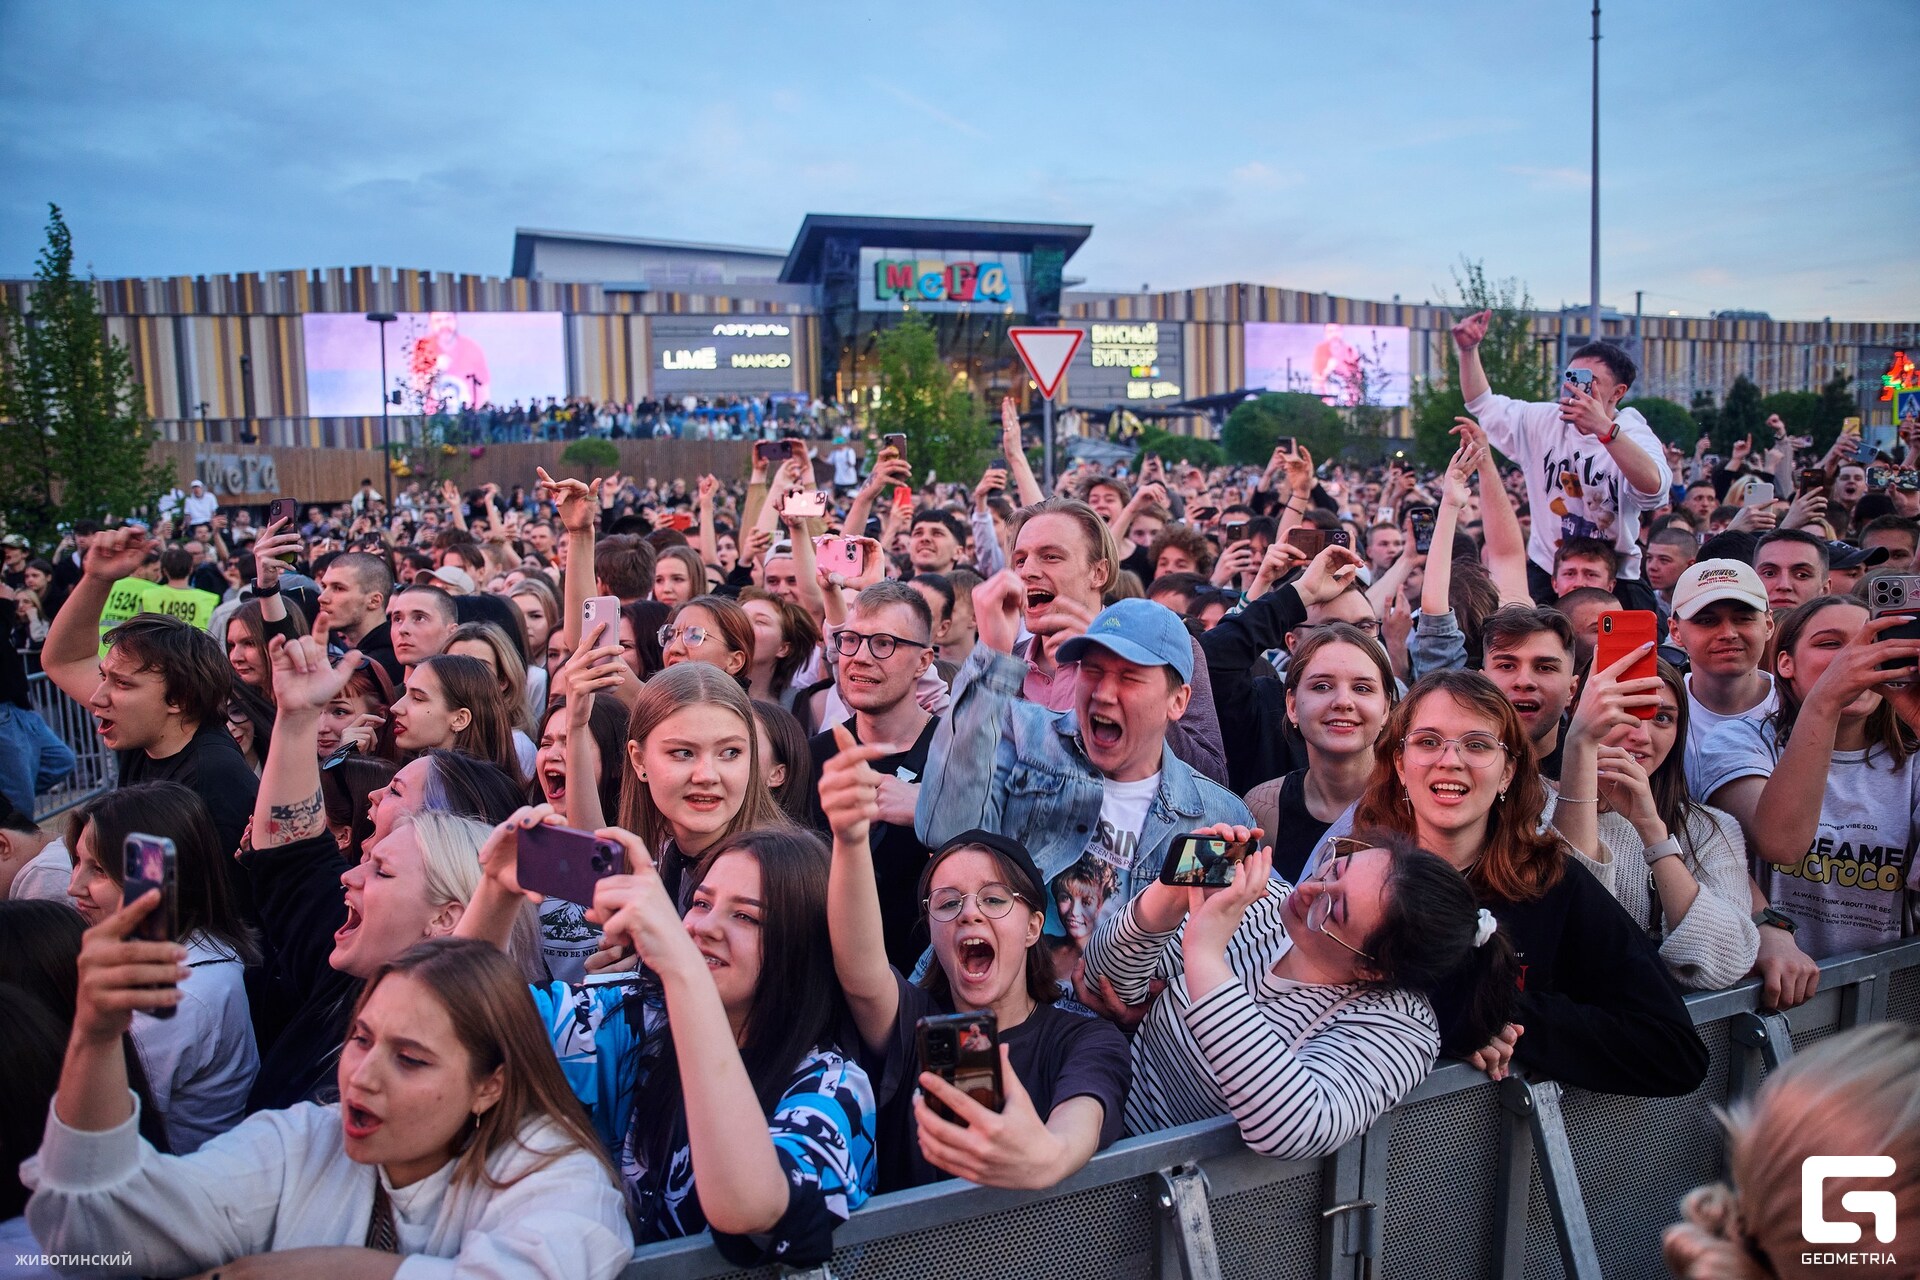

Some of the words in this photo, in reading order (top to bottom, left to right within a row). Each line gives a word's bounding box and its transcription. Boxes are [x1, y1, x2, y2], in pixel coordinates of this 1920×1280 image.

[731, 353, 791, 368] MANGO
[159, 599, 196, 621] 14899
[1088, 843, 1107, 858] SEEN
[1108, 852, 1122, 864] THIS
[1792, 890, 1821, 902] ALWAYS
[1821, 897, 1840, 905] THINK
[1840, 900, 1864, 908] ABOUT
[1865, 903, 1878, 911] THE
[1063, 1000, 1089, 1013] YEARS
